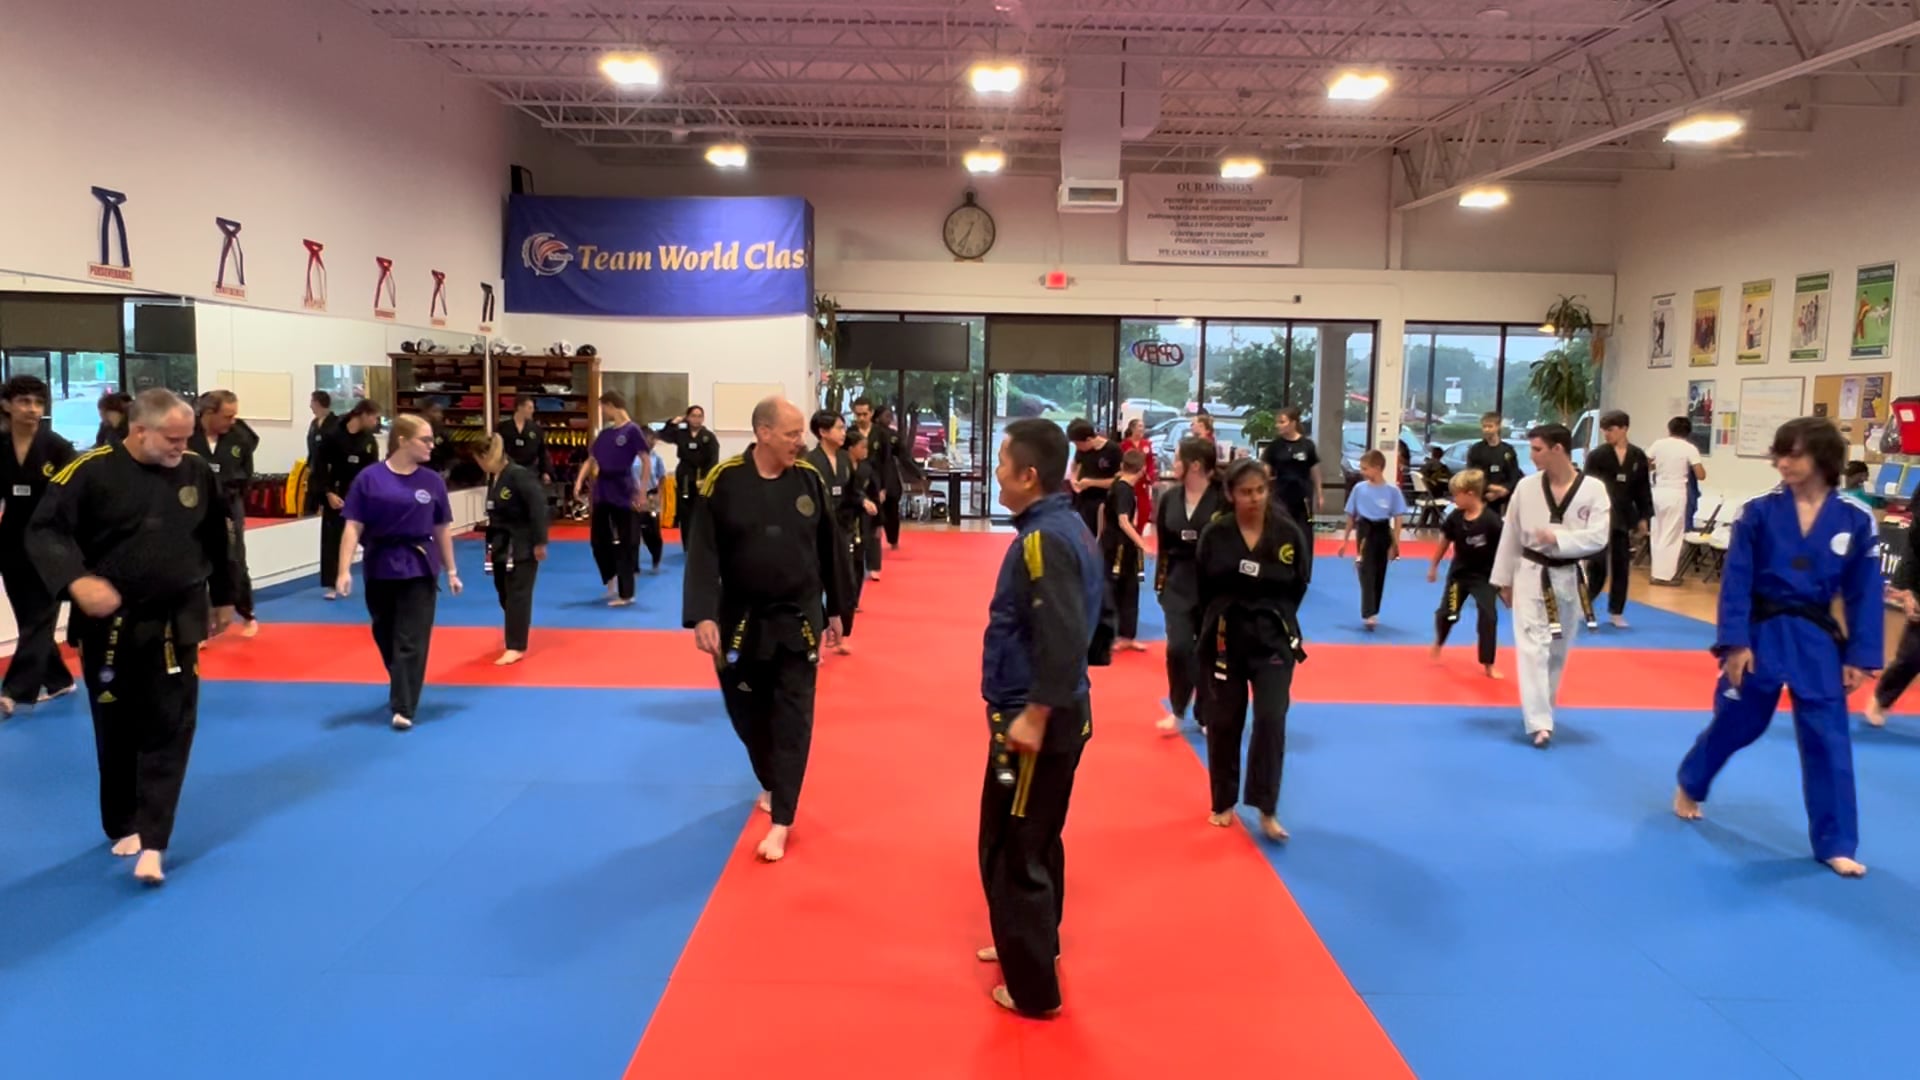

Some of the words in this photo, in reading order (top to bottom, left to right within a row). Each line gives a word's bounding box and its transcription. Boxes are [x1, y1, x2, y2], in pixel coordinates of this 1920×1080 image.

[1177, 182, 1202, 192] OUR
[1205, 182, 1253, 193] MISSION
[577, 245, 651, 270] Team
[658, 241, 739, 271] World
[744, 241, 809, 271] Clas
[1189, 249, 1210, 257] MAKE
